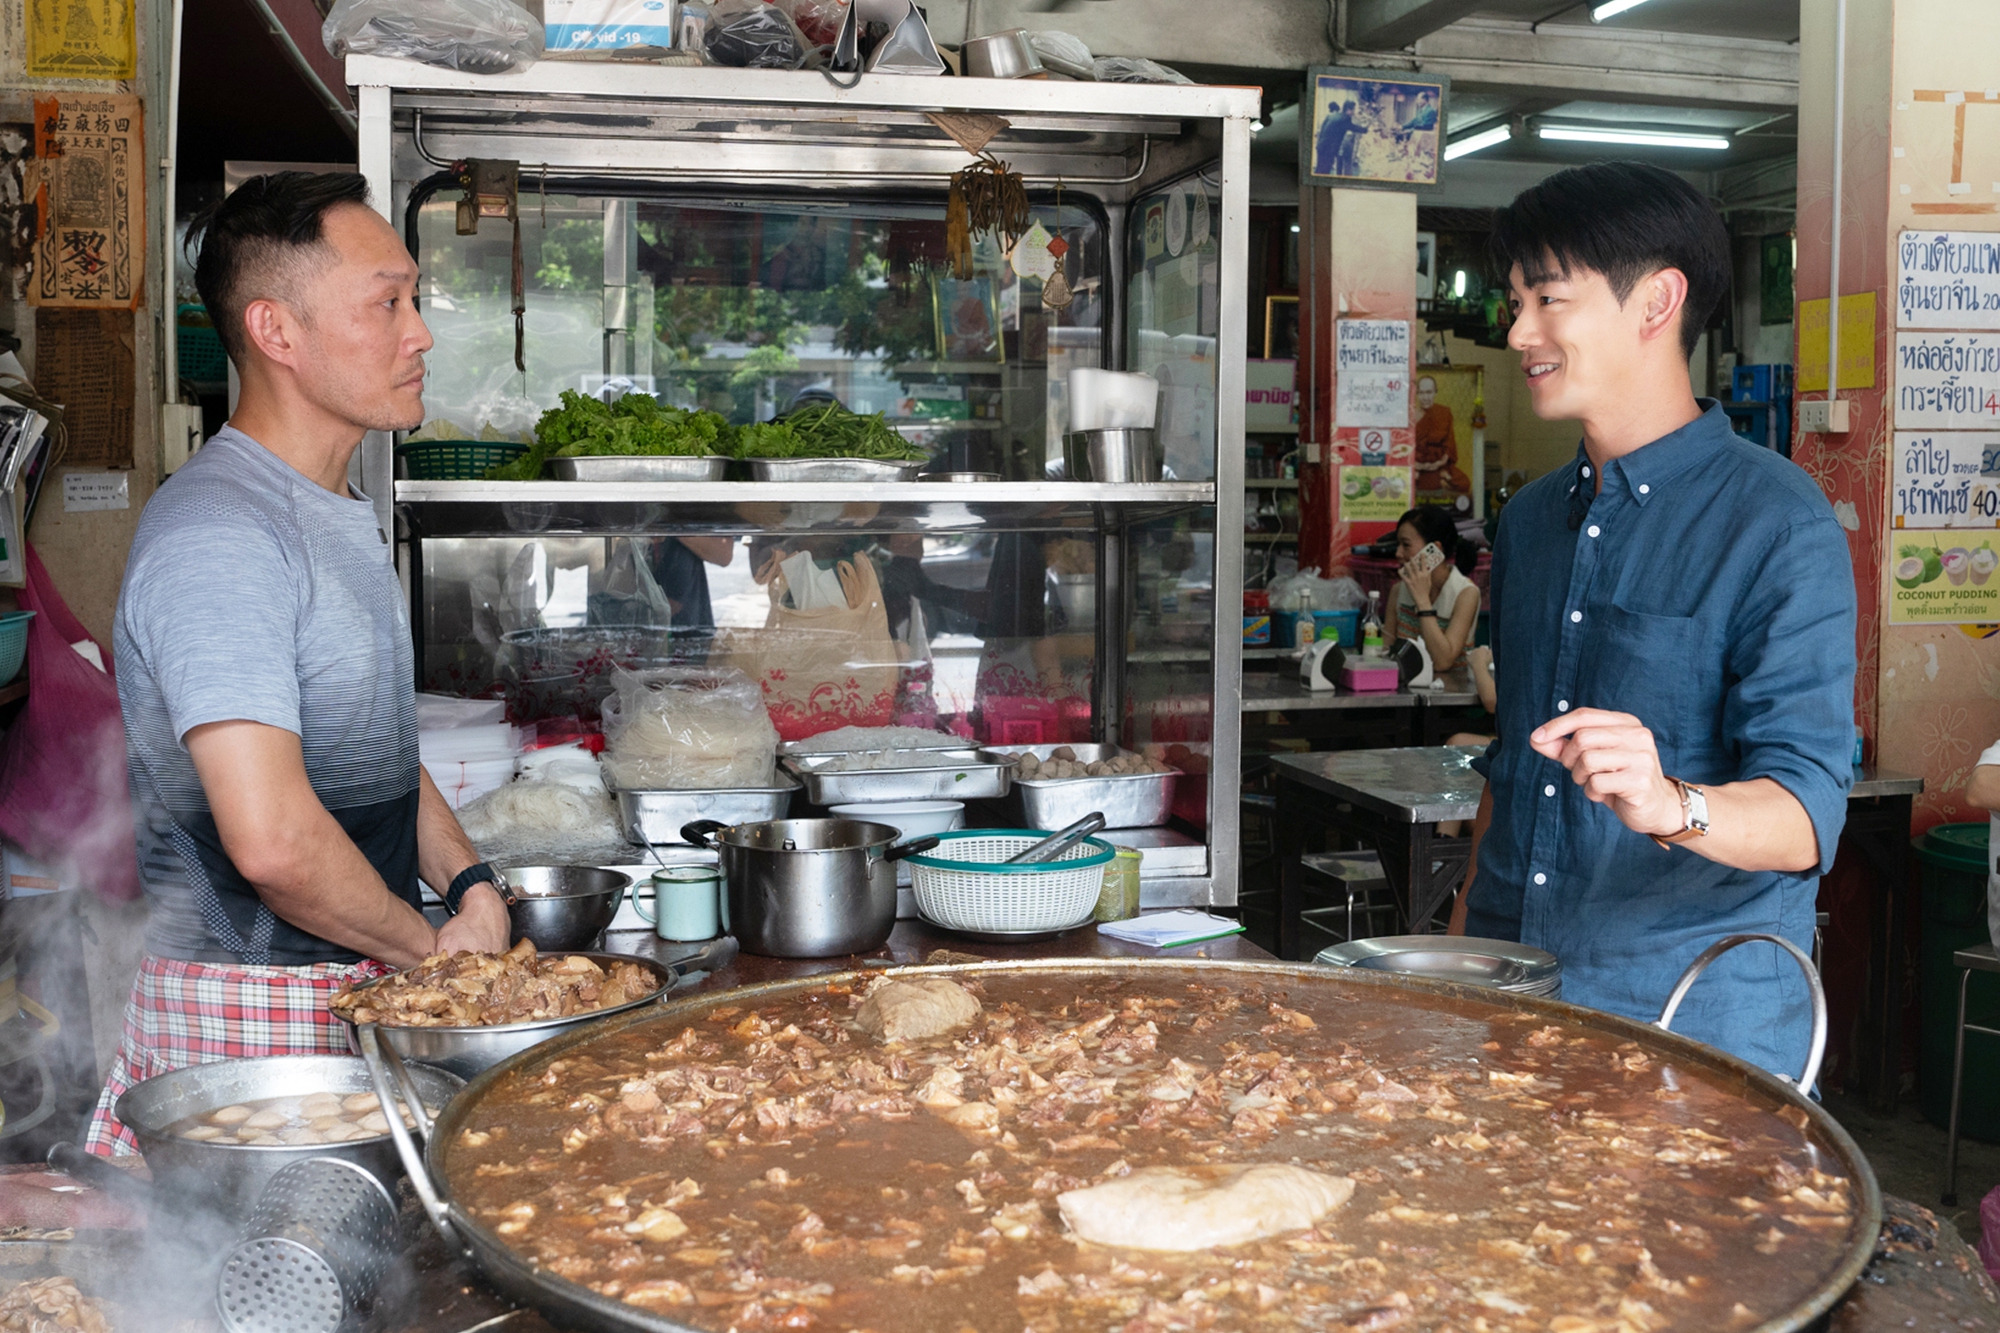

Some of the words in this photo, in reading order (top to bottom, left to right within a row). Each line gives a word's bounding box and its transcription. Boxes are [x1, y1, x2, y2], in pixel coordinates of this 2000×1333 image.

[58, 99, 116, 114] าลเจ้าพ่อเสือ
[1982, 292, 2000, 311] 20
[1387, 380, 1402, 392] 40
[1984, 393, 2000, 416] 4
[1905, 437, 1950, 476] ลำไย
[1898, 478, 1971, 515] น้ำพันช์
[1897, 590, 1946, 600] COCONUT
[1949, 589, 1998, 599] PUDDING
